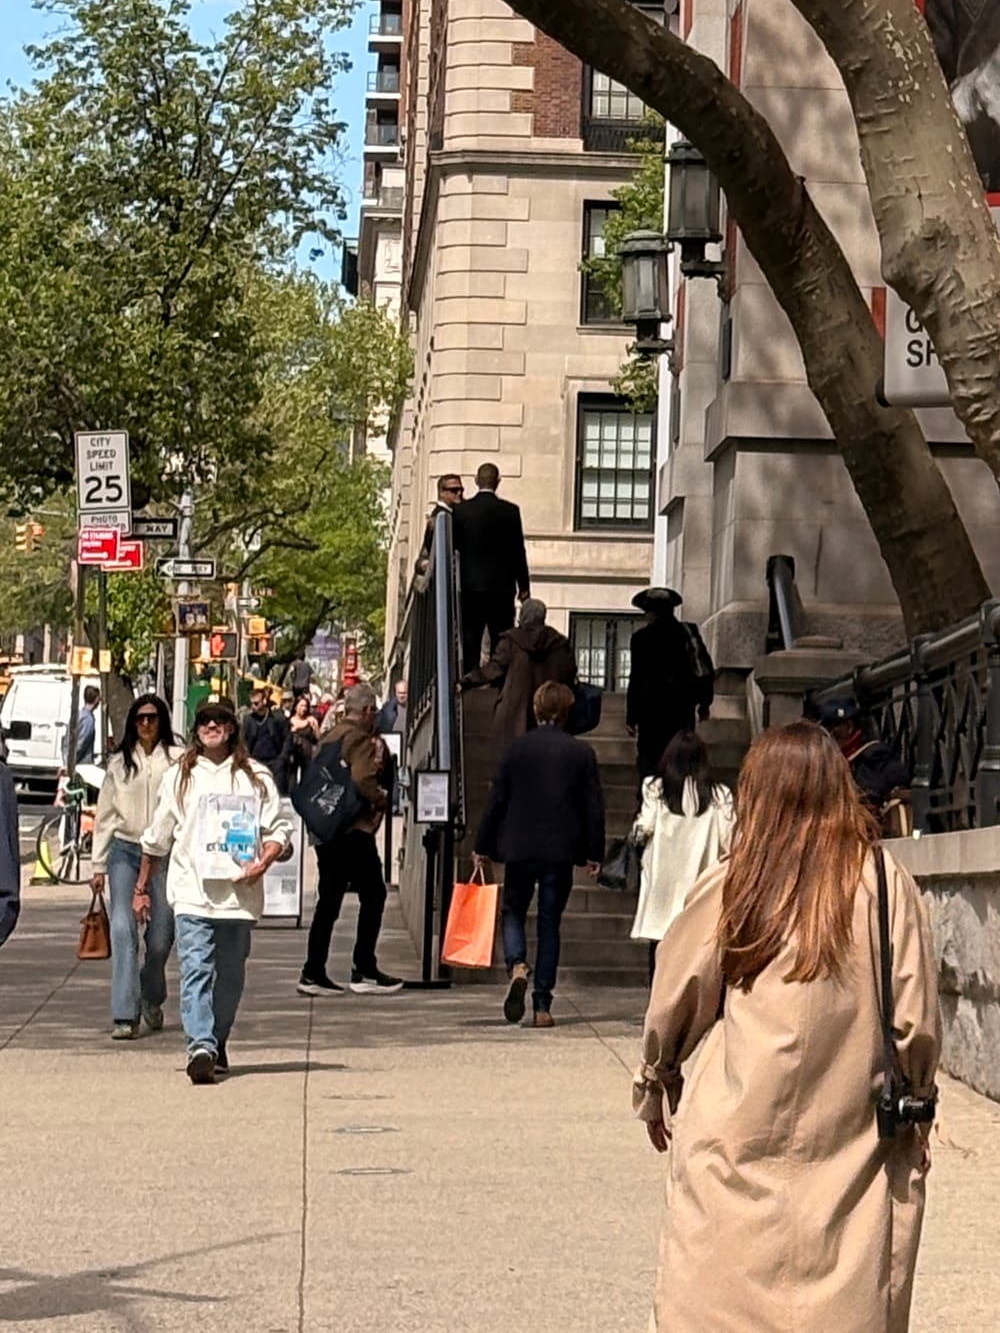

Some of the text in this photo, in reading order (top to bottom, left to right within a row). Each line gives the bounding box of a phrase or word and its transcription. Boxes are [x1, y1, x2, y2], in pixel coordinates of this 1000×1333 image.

[90, 437, 111, 447] CITY
[87, 449, 116, 460] SPEED
[90, 461, 113, 471] LIMIT
[85, 475, 122, 504] 25
[91, 515, 118, 524] PHOTO
